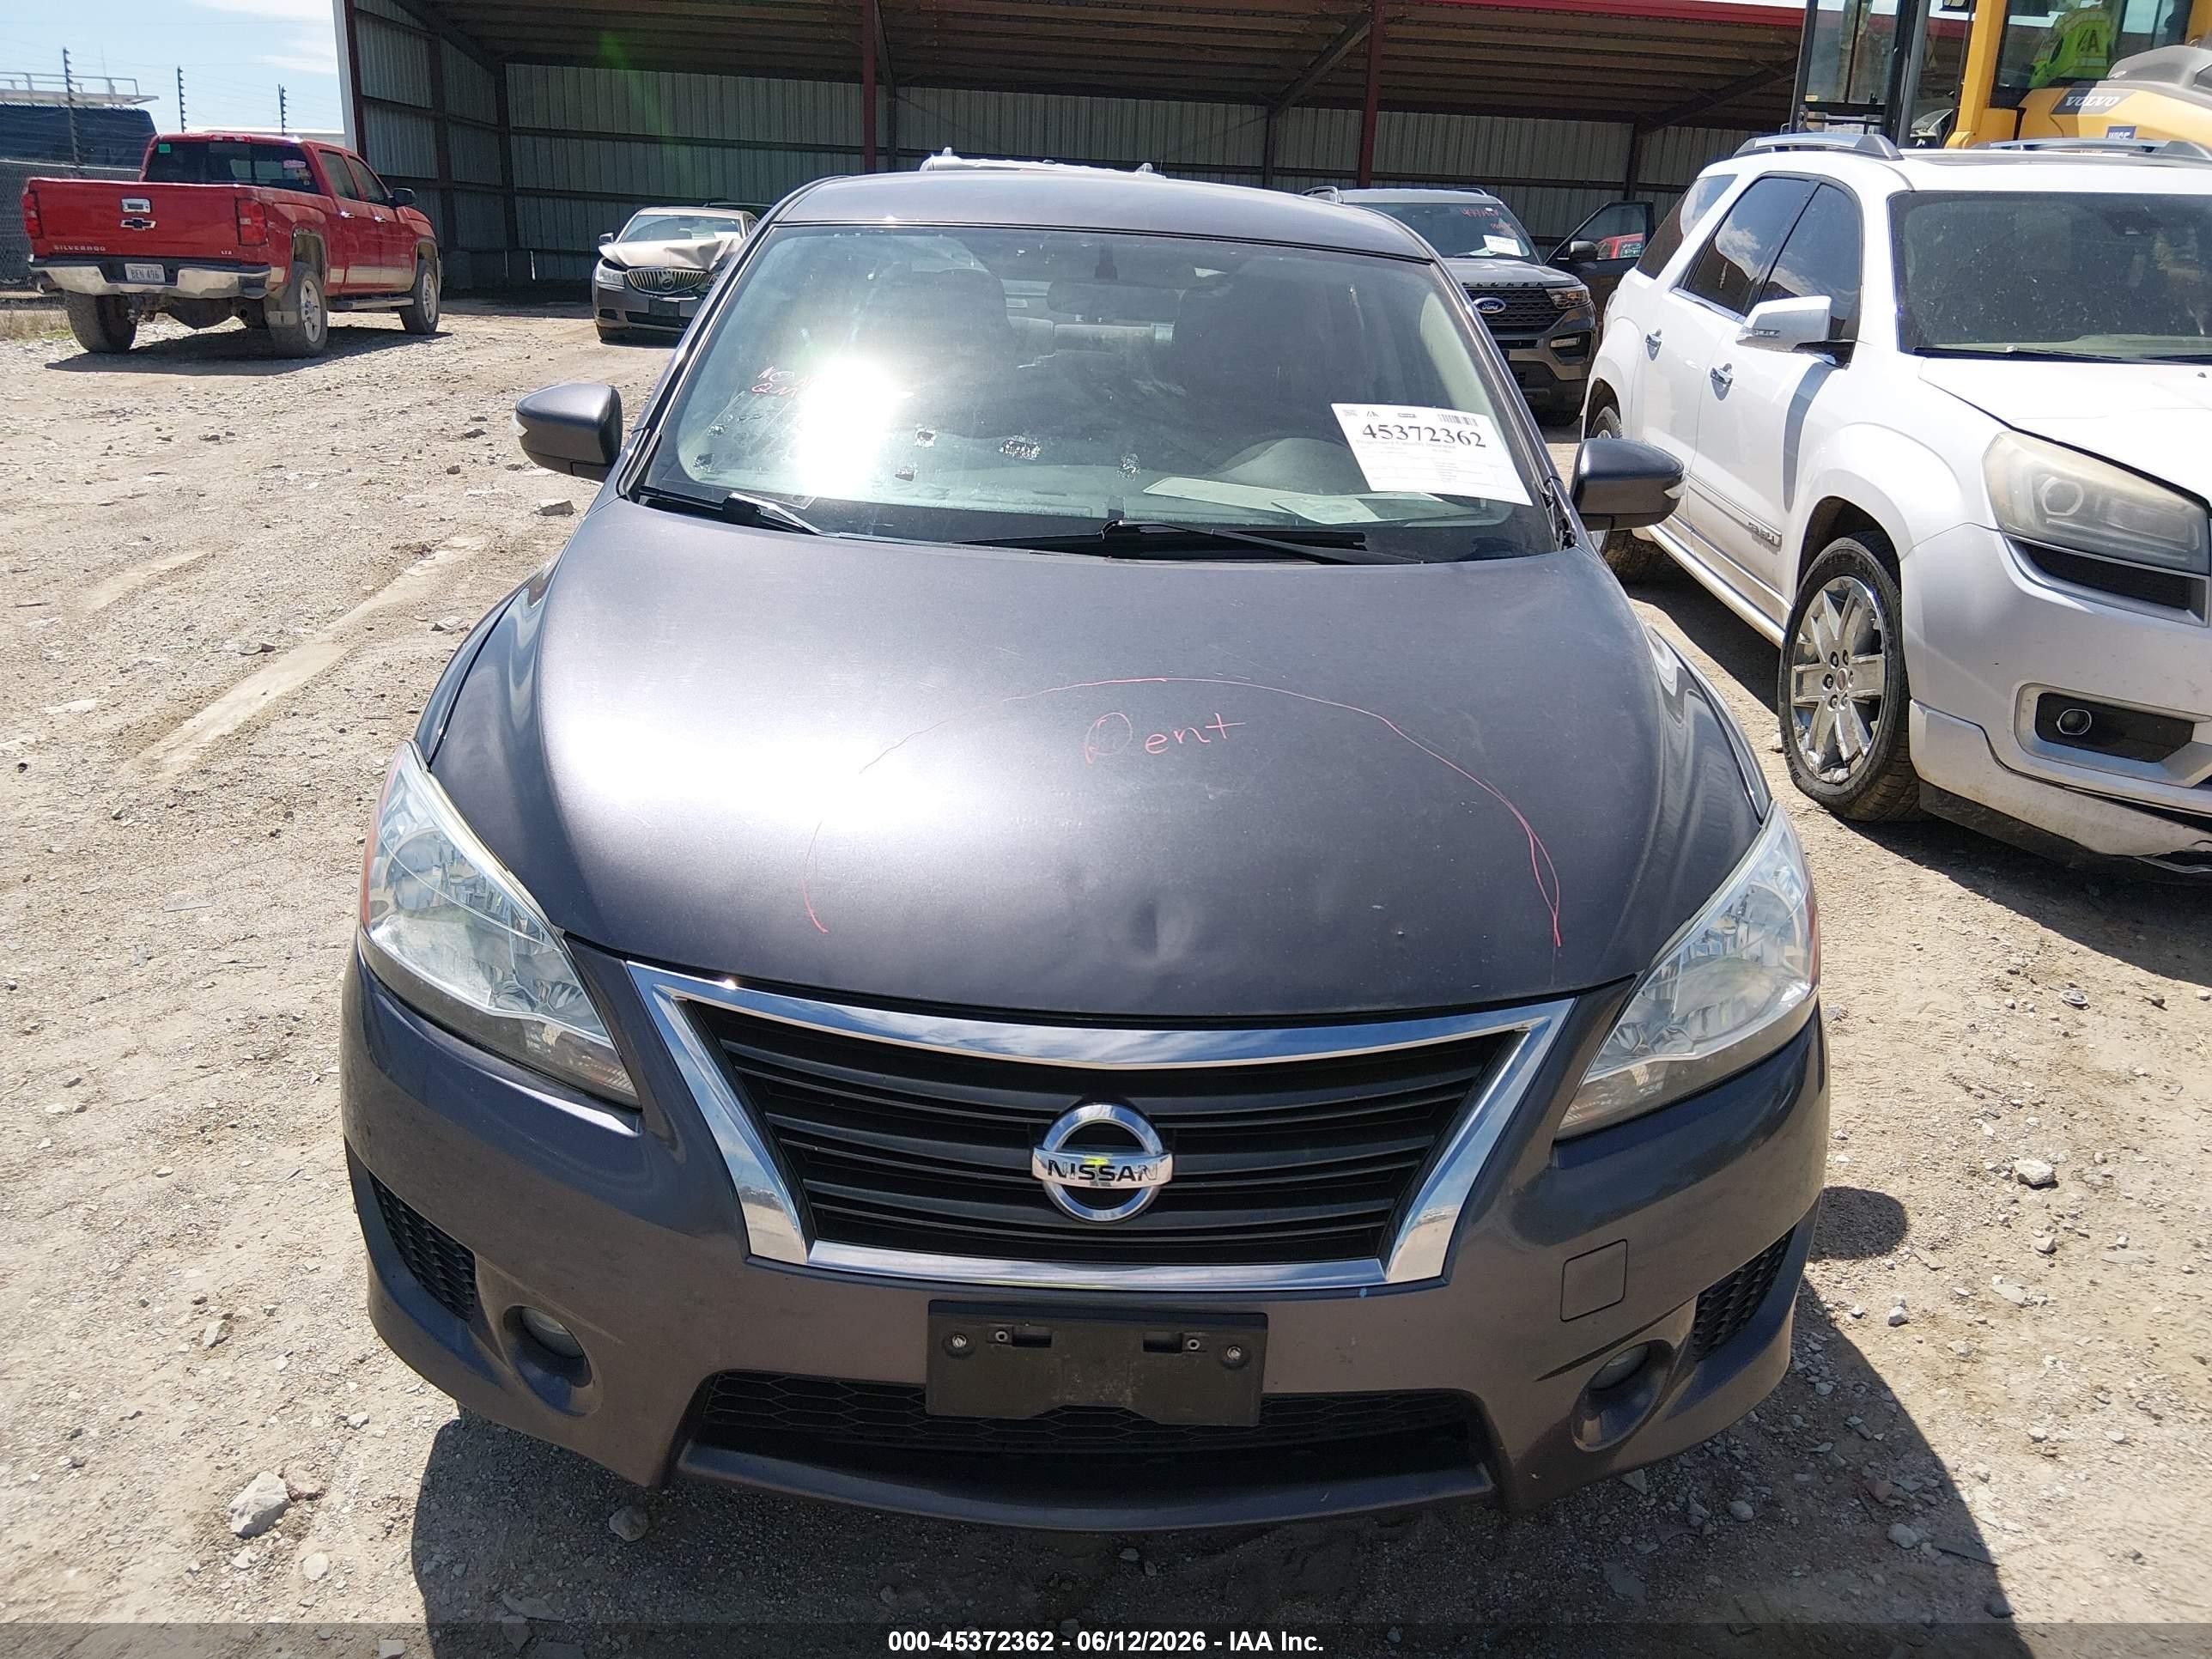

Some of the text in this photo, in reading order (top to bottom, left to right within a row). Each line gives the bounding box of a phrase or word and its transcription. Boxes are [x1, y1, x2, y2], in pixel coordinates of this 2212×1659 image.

[2065, 95, 2120, 106] VOLVO
[1362, 423, 1487, 448] 45372362
[1048, 1159, 1158, 1182] NISSAN
